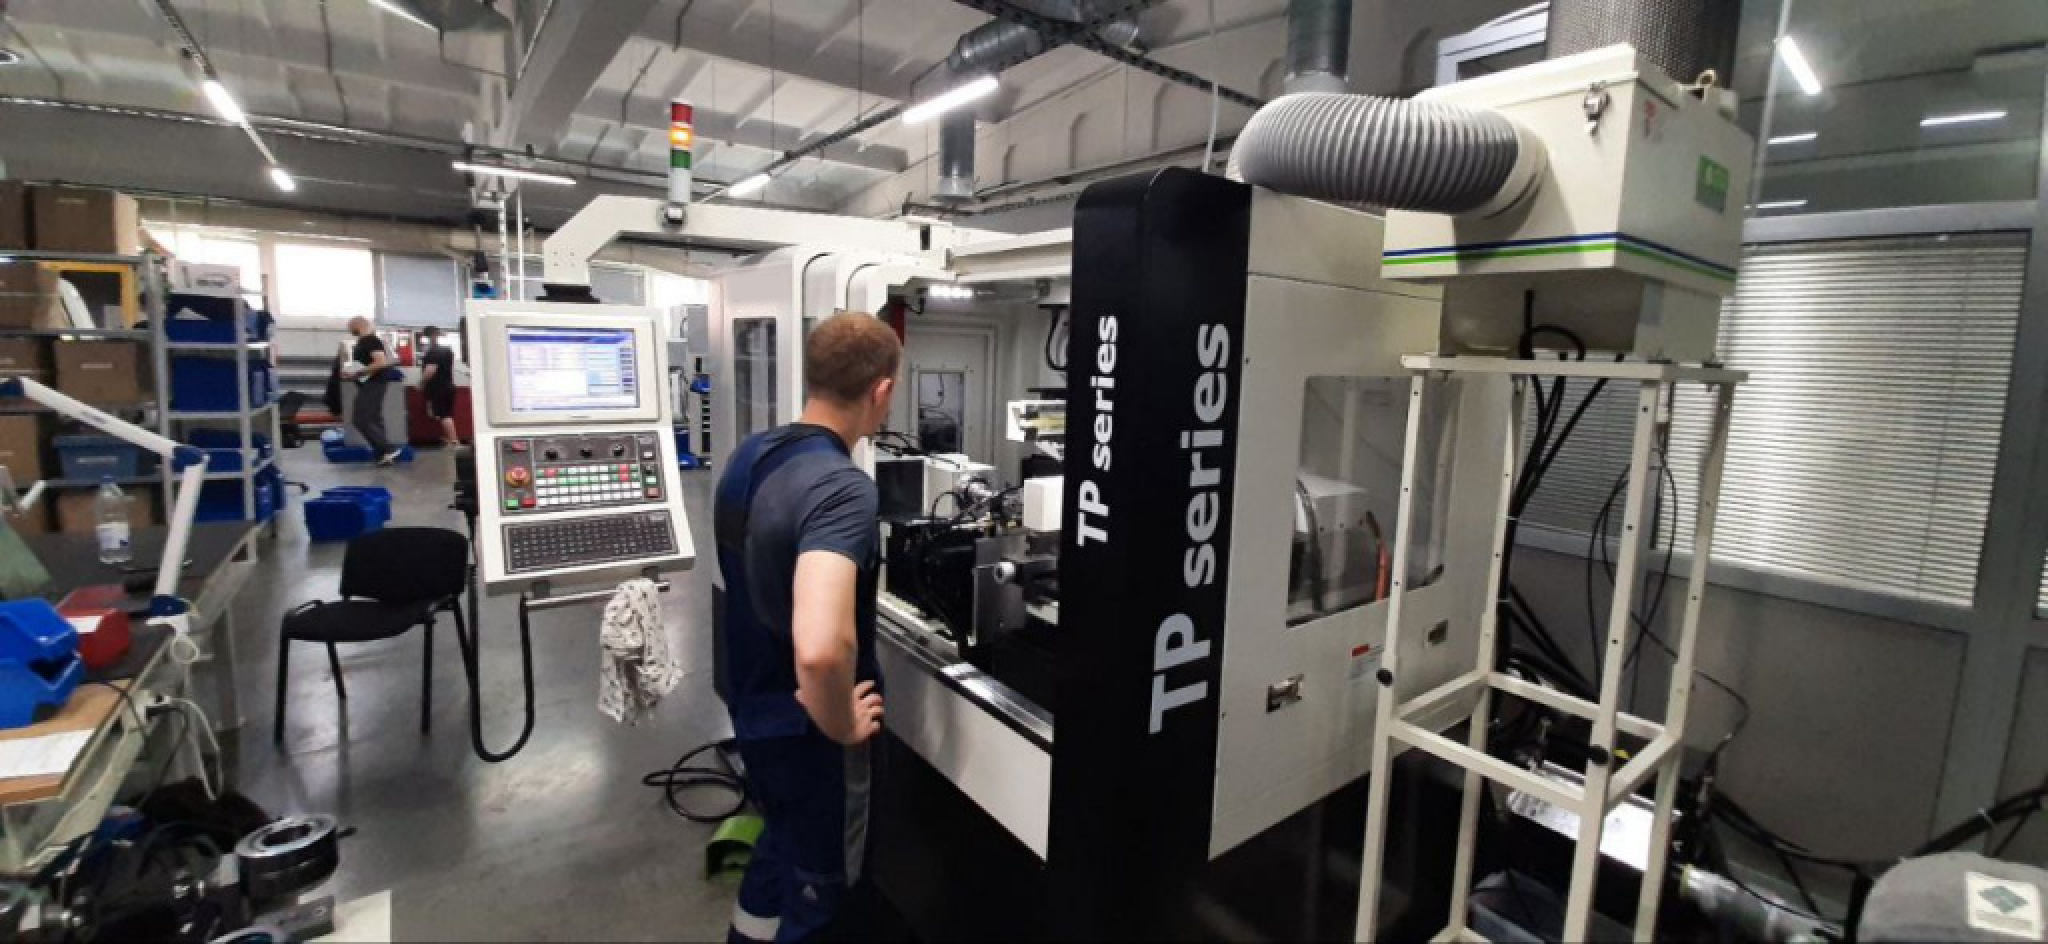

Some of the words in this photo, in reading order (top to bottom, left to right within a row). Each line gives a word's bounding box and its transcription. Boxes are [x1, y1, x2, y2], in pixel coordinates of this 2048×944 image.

[1090, 315, 1119, 472] series
[1077, 480, 1109, 547] TP
[1149, 612, 1211, 734] TP
[1180, 323, 1230, 588] series
